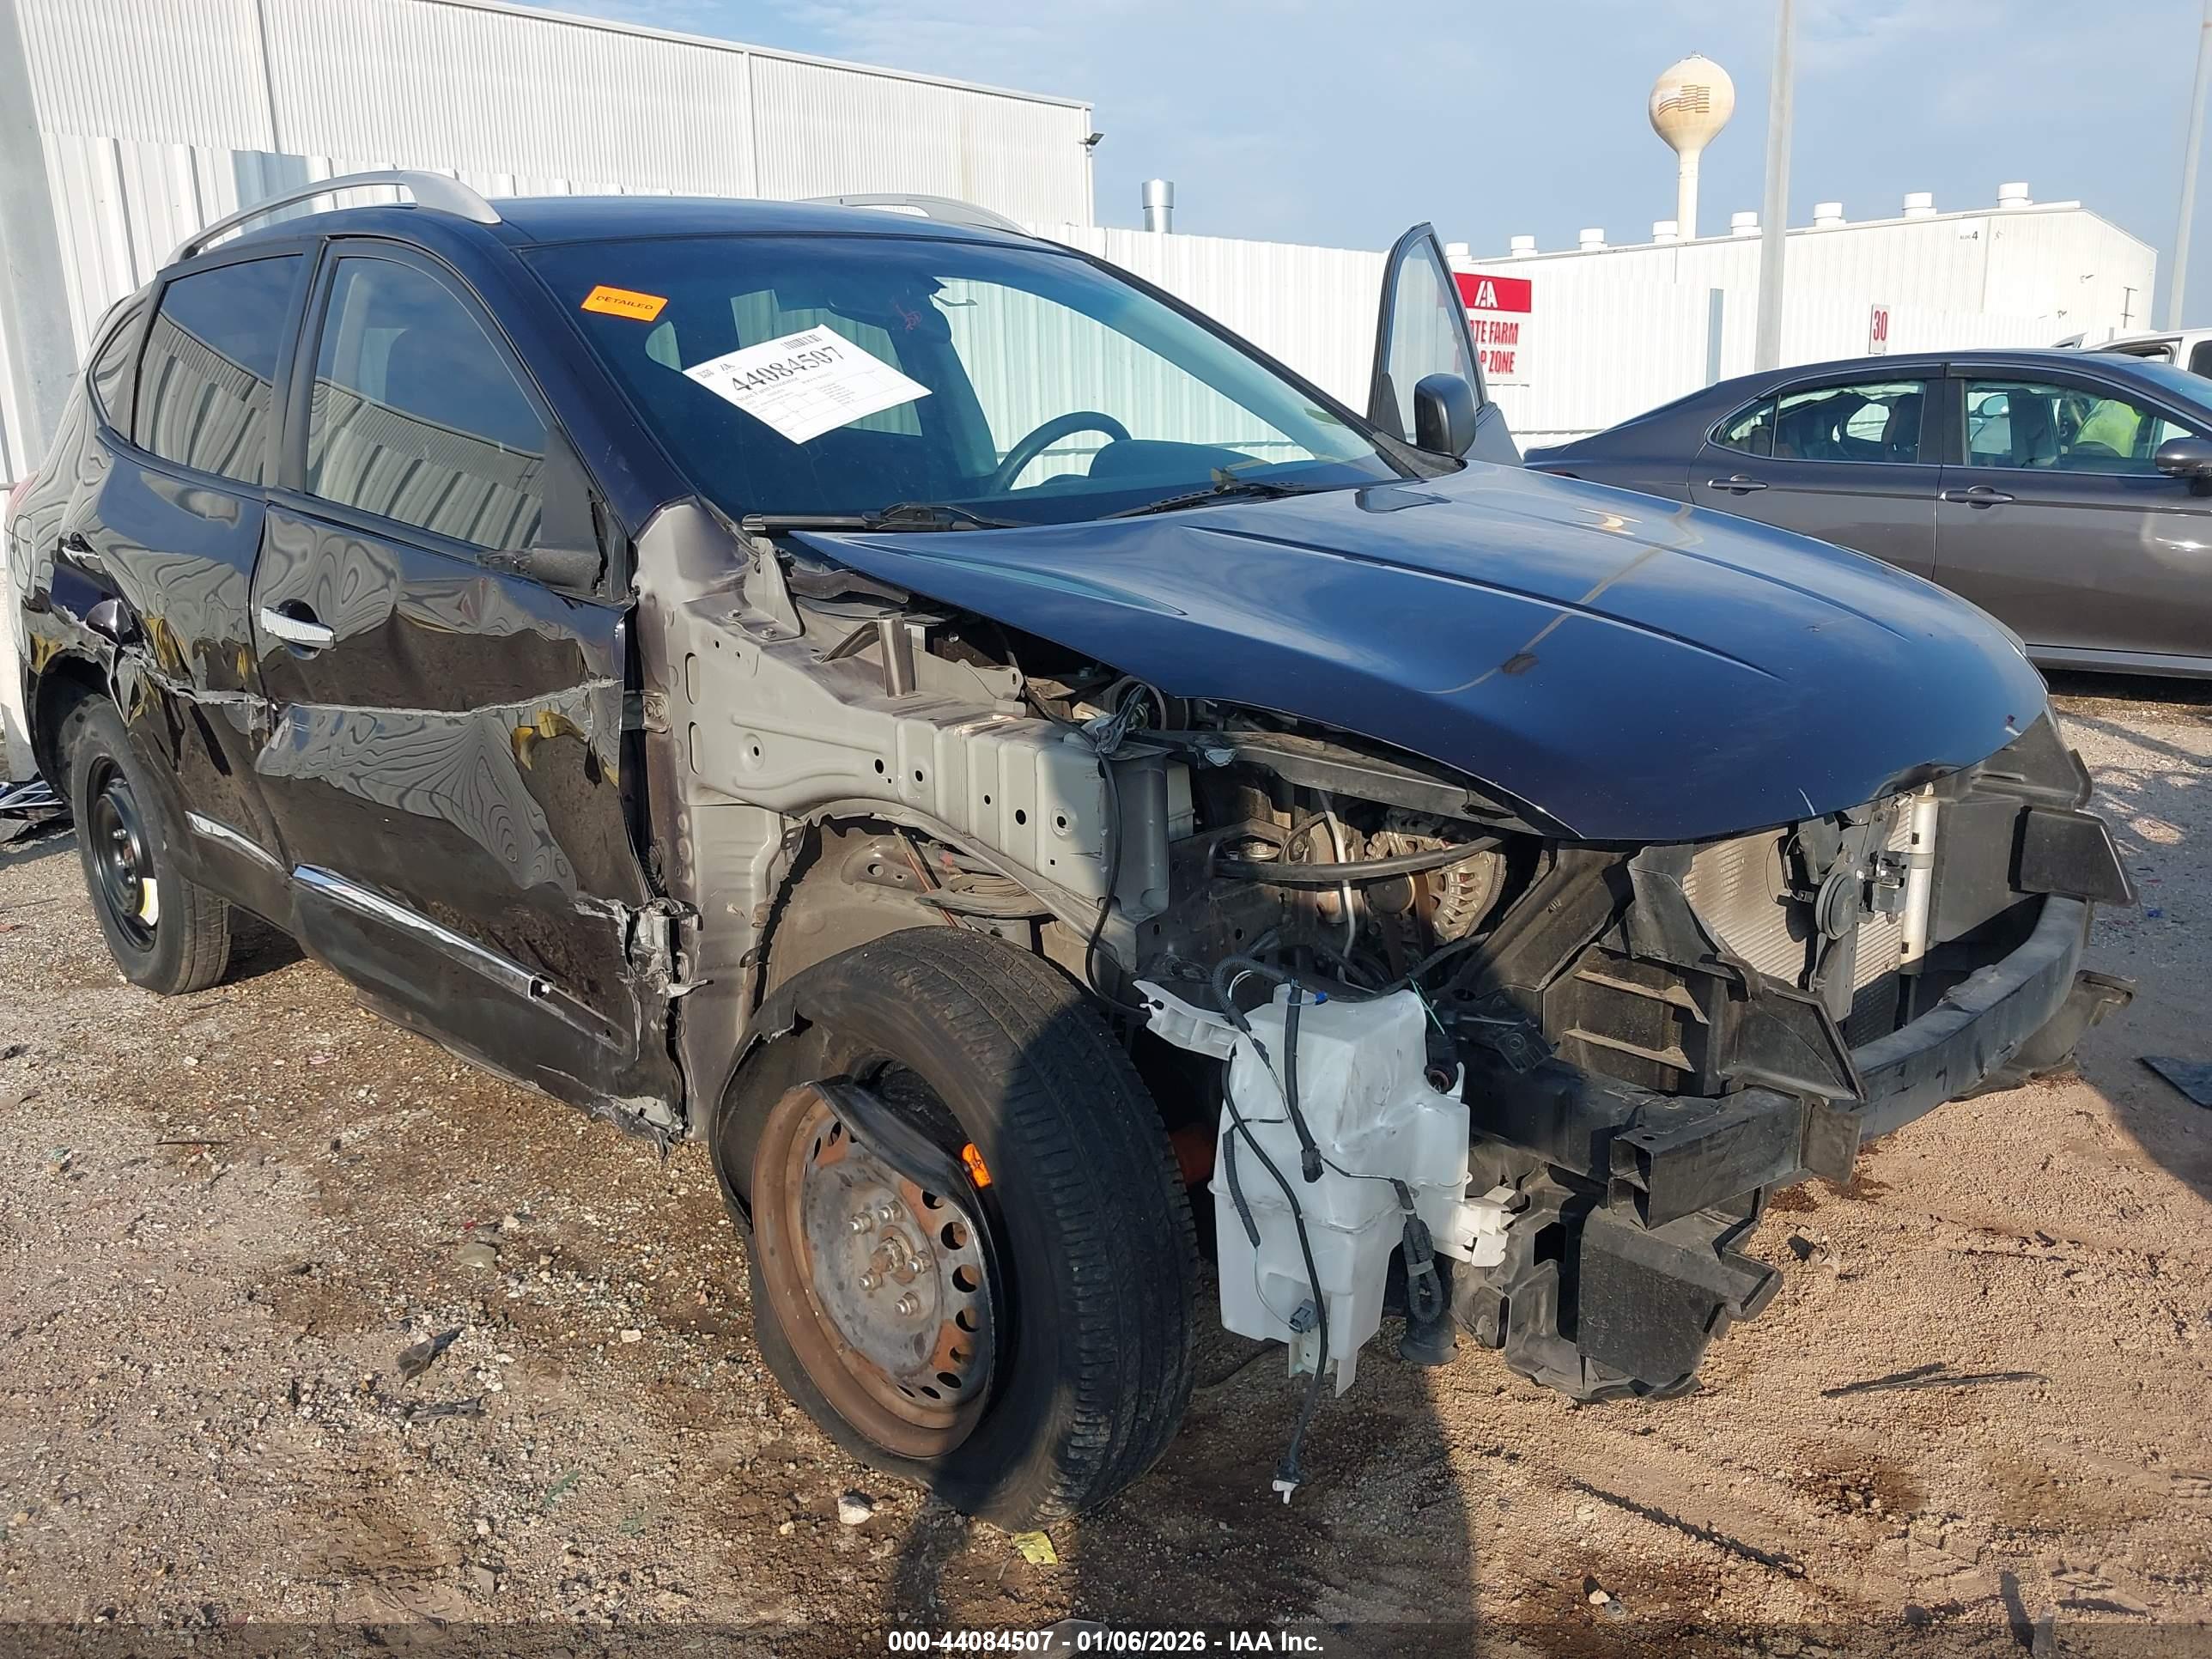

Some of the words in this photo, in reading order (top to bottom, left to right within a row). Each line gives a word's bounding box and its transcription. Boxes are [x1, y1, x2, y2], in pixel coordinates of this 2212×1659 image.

[1972, 230, 1978, 240] 4
[595, 295, 653, 310] DETAILED
[1489, 321, 1519, 345] FARM
[1873, 310, 1888, 342] 30
[732, 346, 844, 392] 44084507
[1488, 350, 1516, 374] ZONE
